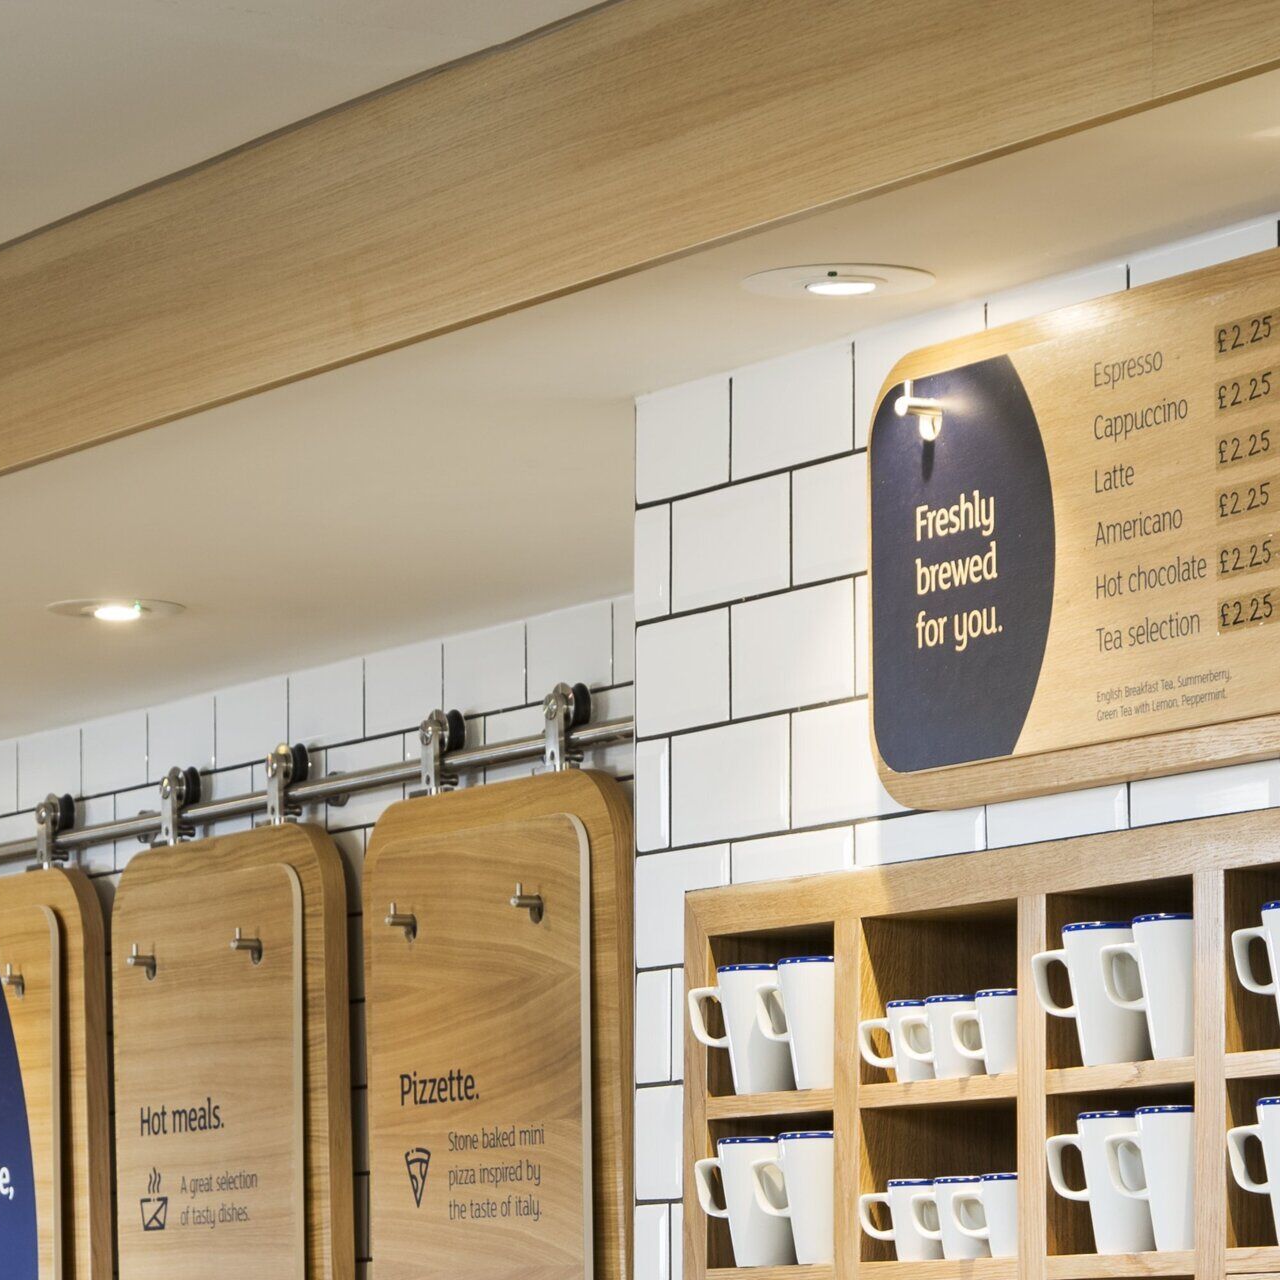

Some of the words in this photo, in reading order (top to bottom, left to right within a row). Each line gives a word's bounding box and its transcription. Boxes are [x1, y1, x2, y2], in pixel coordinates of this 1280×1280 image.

[1217, 316, 1272, 352] £2.25
[1094, 352, 1163, 389] Espresso
[1219, 372, 1272, 409] £2.25
[1094, 398, 1188, 442] Cappuccino
[1219, 430, 1270, 463] £2.25
[1095, 464, 1134, 493] Latte
[915, 490, 995, 542] Freshly
[1220, 482, 1270, 517] £2.25
[1095, 508, 1183, 546] Americano
[916, 542, 998, 595] brewed
[1220, 540, 1272, 574] £2.25
[1096, 574, 1123, 600] Hot
[1128, 556, 1207, 592] chocolate
[1221, 594, 1272, 626] £2.25
[916, 611, 947, 649] for
[954, 605, 1003, 652] you.
[1096, 627, 1122, 652] Tea
[1128, 613, 1200, 647] selection
[1096, 687, 1122, 704] English
[1125, 681, 1158, 697] Breakfast
[1096, 710, 1118, 721] Green
[1120, 706, 1132, 717] Tea
[1134, 702, 1150, 714] with
[400, 1069, 480, 1106] Pizzette.
[140, 1105, 167, 1136] Hot
[172, 1097, 224, 1133] meals.
[448, 1131, 478, 1151] Stone
[482, 1125, 516, 1148] baked
[519, 1124, 544, 1146] mini
[180, 1176, 187, 1194] A
[190, 1174, 213, 1198] great
[216, 1170, 258, 1192] selection
[448, 1165, 476, 1190] pizza
[480, 1160, 522, 1188] inspired
[526, 1159, 541, 1186] by
[180, 1206, 189, 1226] of
[192, 1205, 216, 1228] tasty
[218, 1202, 250, 1222] dishes.
[449, 1199, 466, 1220] the
[470, 1198, 497, 1218] taste
[500, 1195, 512, 1216] of
[515, 1194, 542, 1222] italy.
